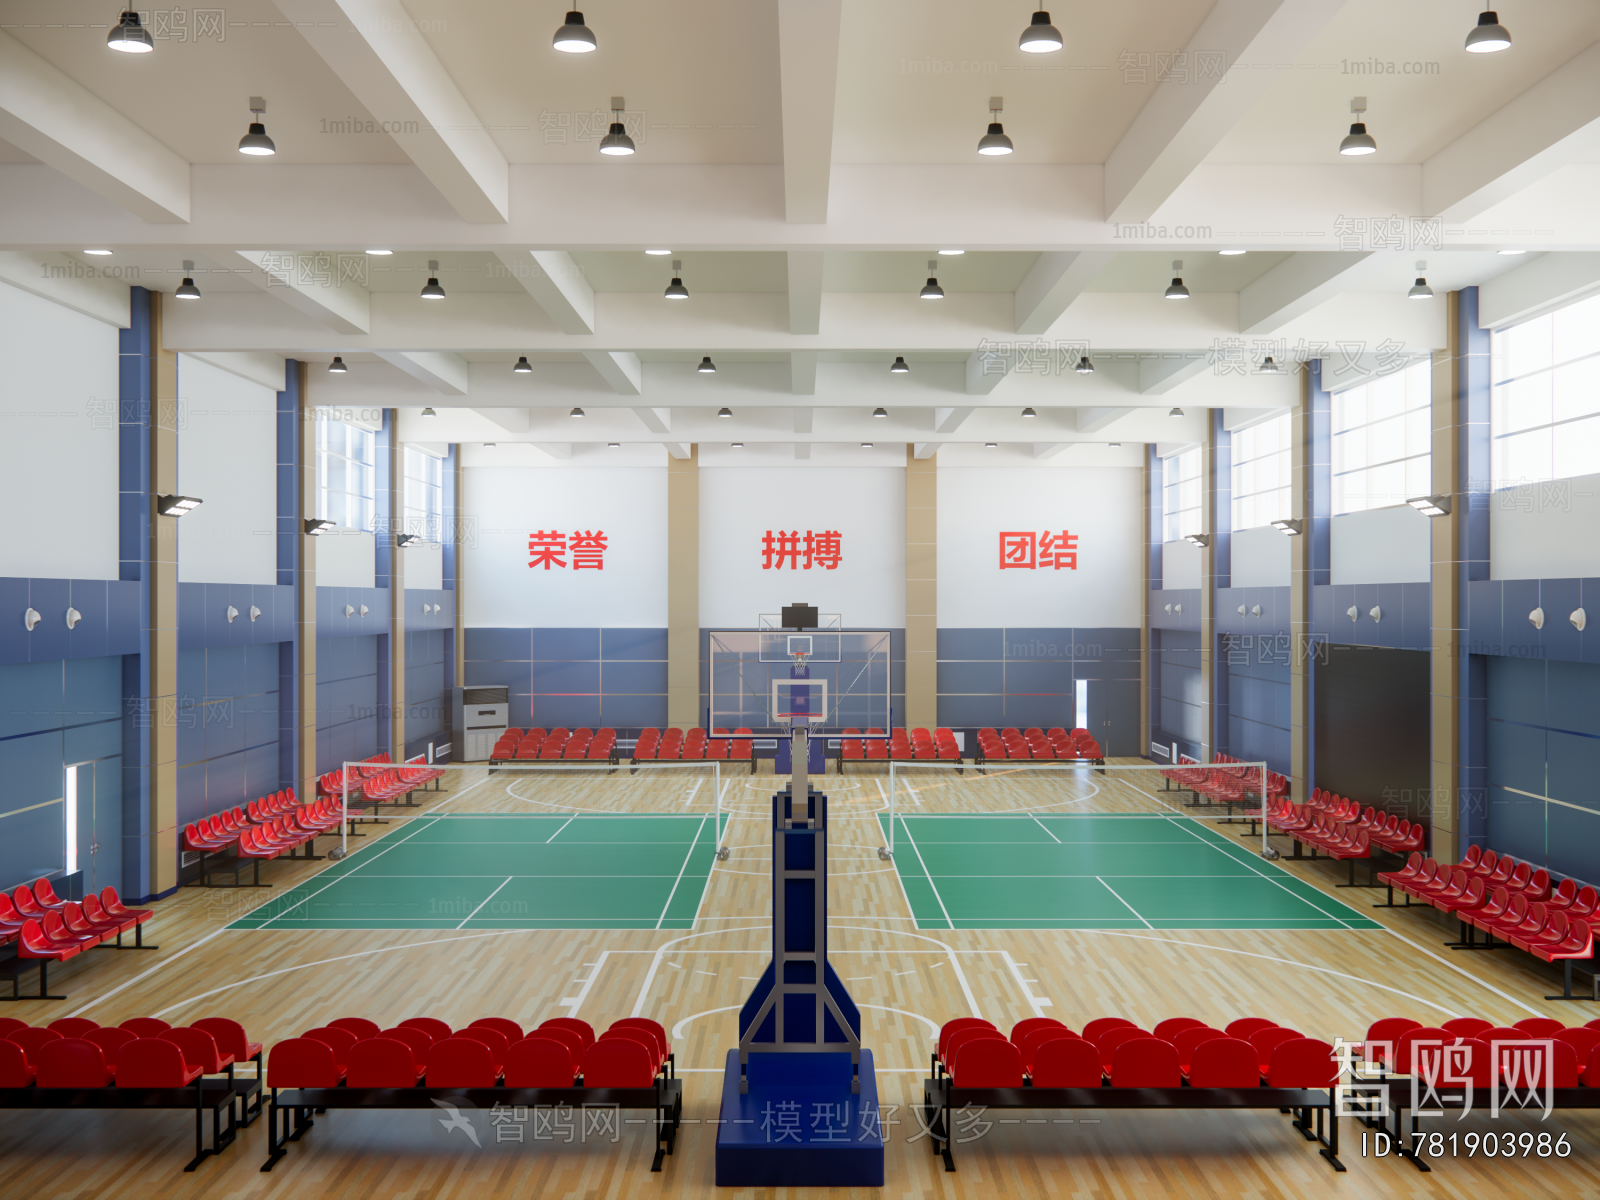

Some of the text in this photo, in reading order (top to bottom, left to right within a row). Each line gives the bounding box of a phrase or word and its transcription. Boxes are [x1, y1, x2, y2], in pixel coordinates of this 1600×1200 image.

[527, 530, 609, 571] 荣誉
[761, 530, 843, 571] 拼搏
[998, 530, 1079, 571] 团结
